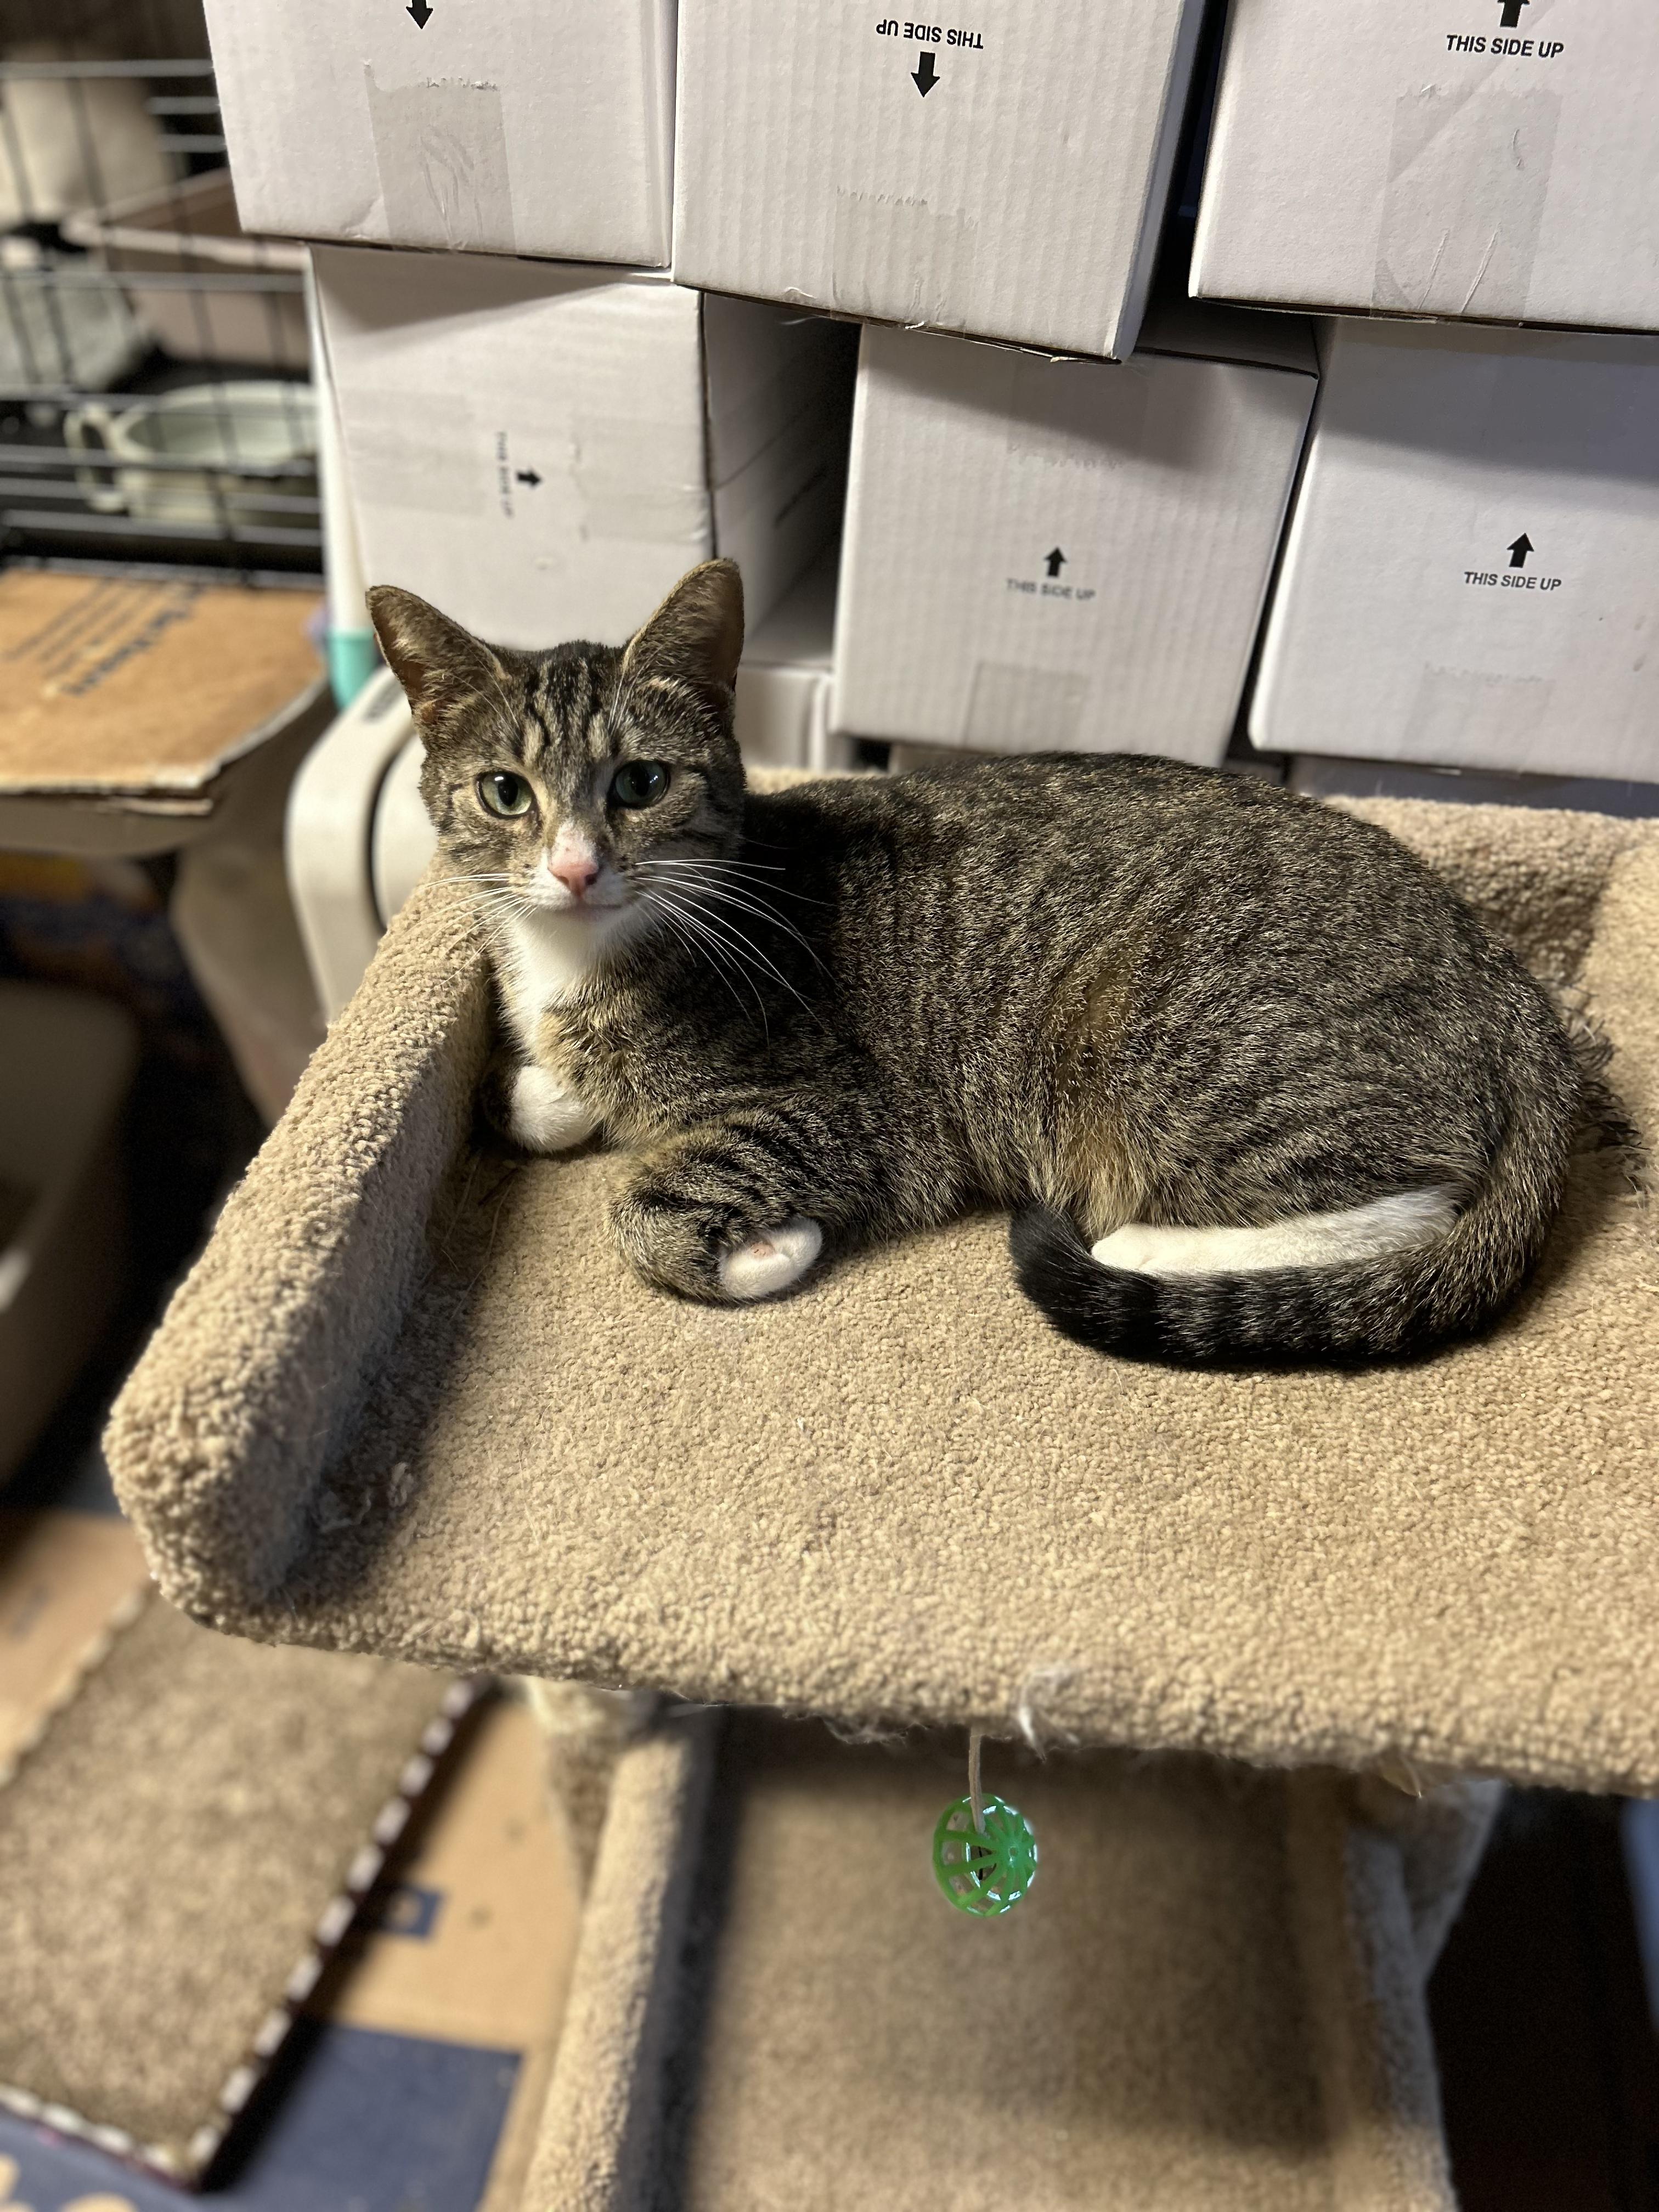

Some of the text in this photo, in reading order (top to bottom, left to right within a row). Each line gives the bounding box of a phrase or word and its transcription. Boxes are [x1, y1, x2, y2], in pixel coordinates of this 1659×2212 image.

[876, 19, 984, 49] THIS SIDE UP
[1446, 34, 1564, 58] THIS SIDE UP
[1464, 571, 1562, 591] THIS SIDE UP
